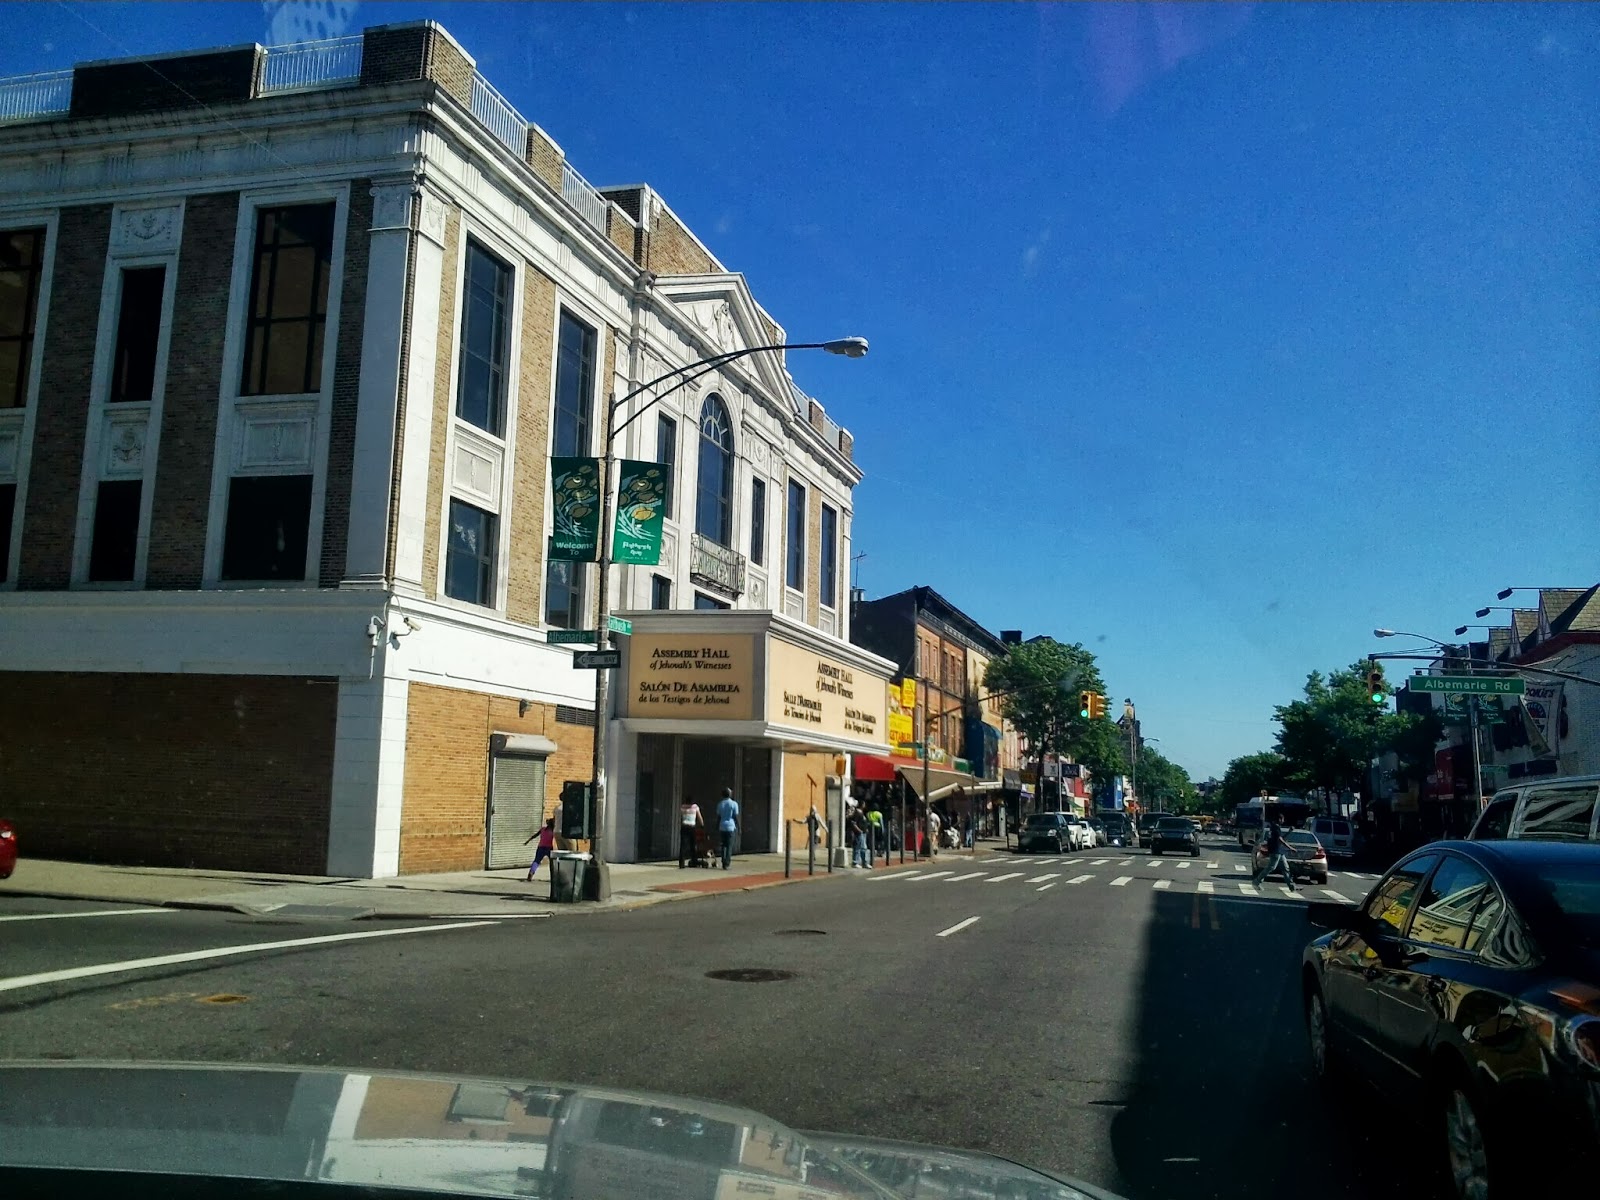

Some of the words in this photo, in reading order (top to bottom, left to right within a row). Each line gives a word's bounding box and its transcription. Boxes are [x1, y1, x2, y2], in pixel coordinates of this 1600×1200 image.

[548, 631, 586, 642] Albemarle
[652, 648, 700, 658] ASSEMBLY
[702, 648, 730, 658] HALL
[650, 660, 658, 670] of
[659, 660, 692, 670] Jehovah's
[695, 661, 731, 669] Witnesses
[690, 682, 739, 692] ASAMBLEA
[1425, 680, 1487, 690] Albemarle
[1495, 681, 1510, 690] Rd
[639, 694, 647, 702] de
[650, 694, 659, 702] los
[662, 694, 690, 704] Testigos
[693, 695, 702, 703] de
